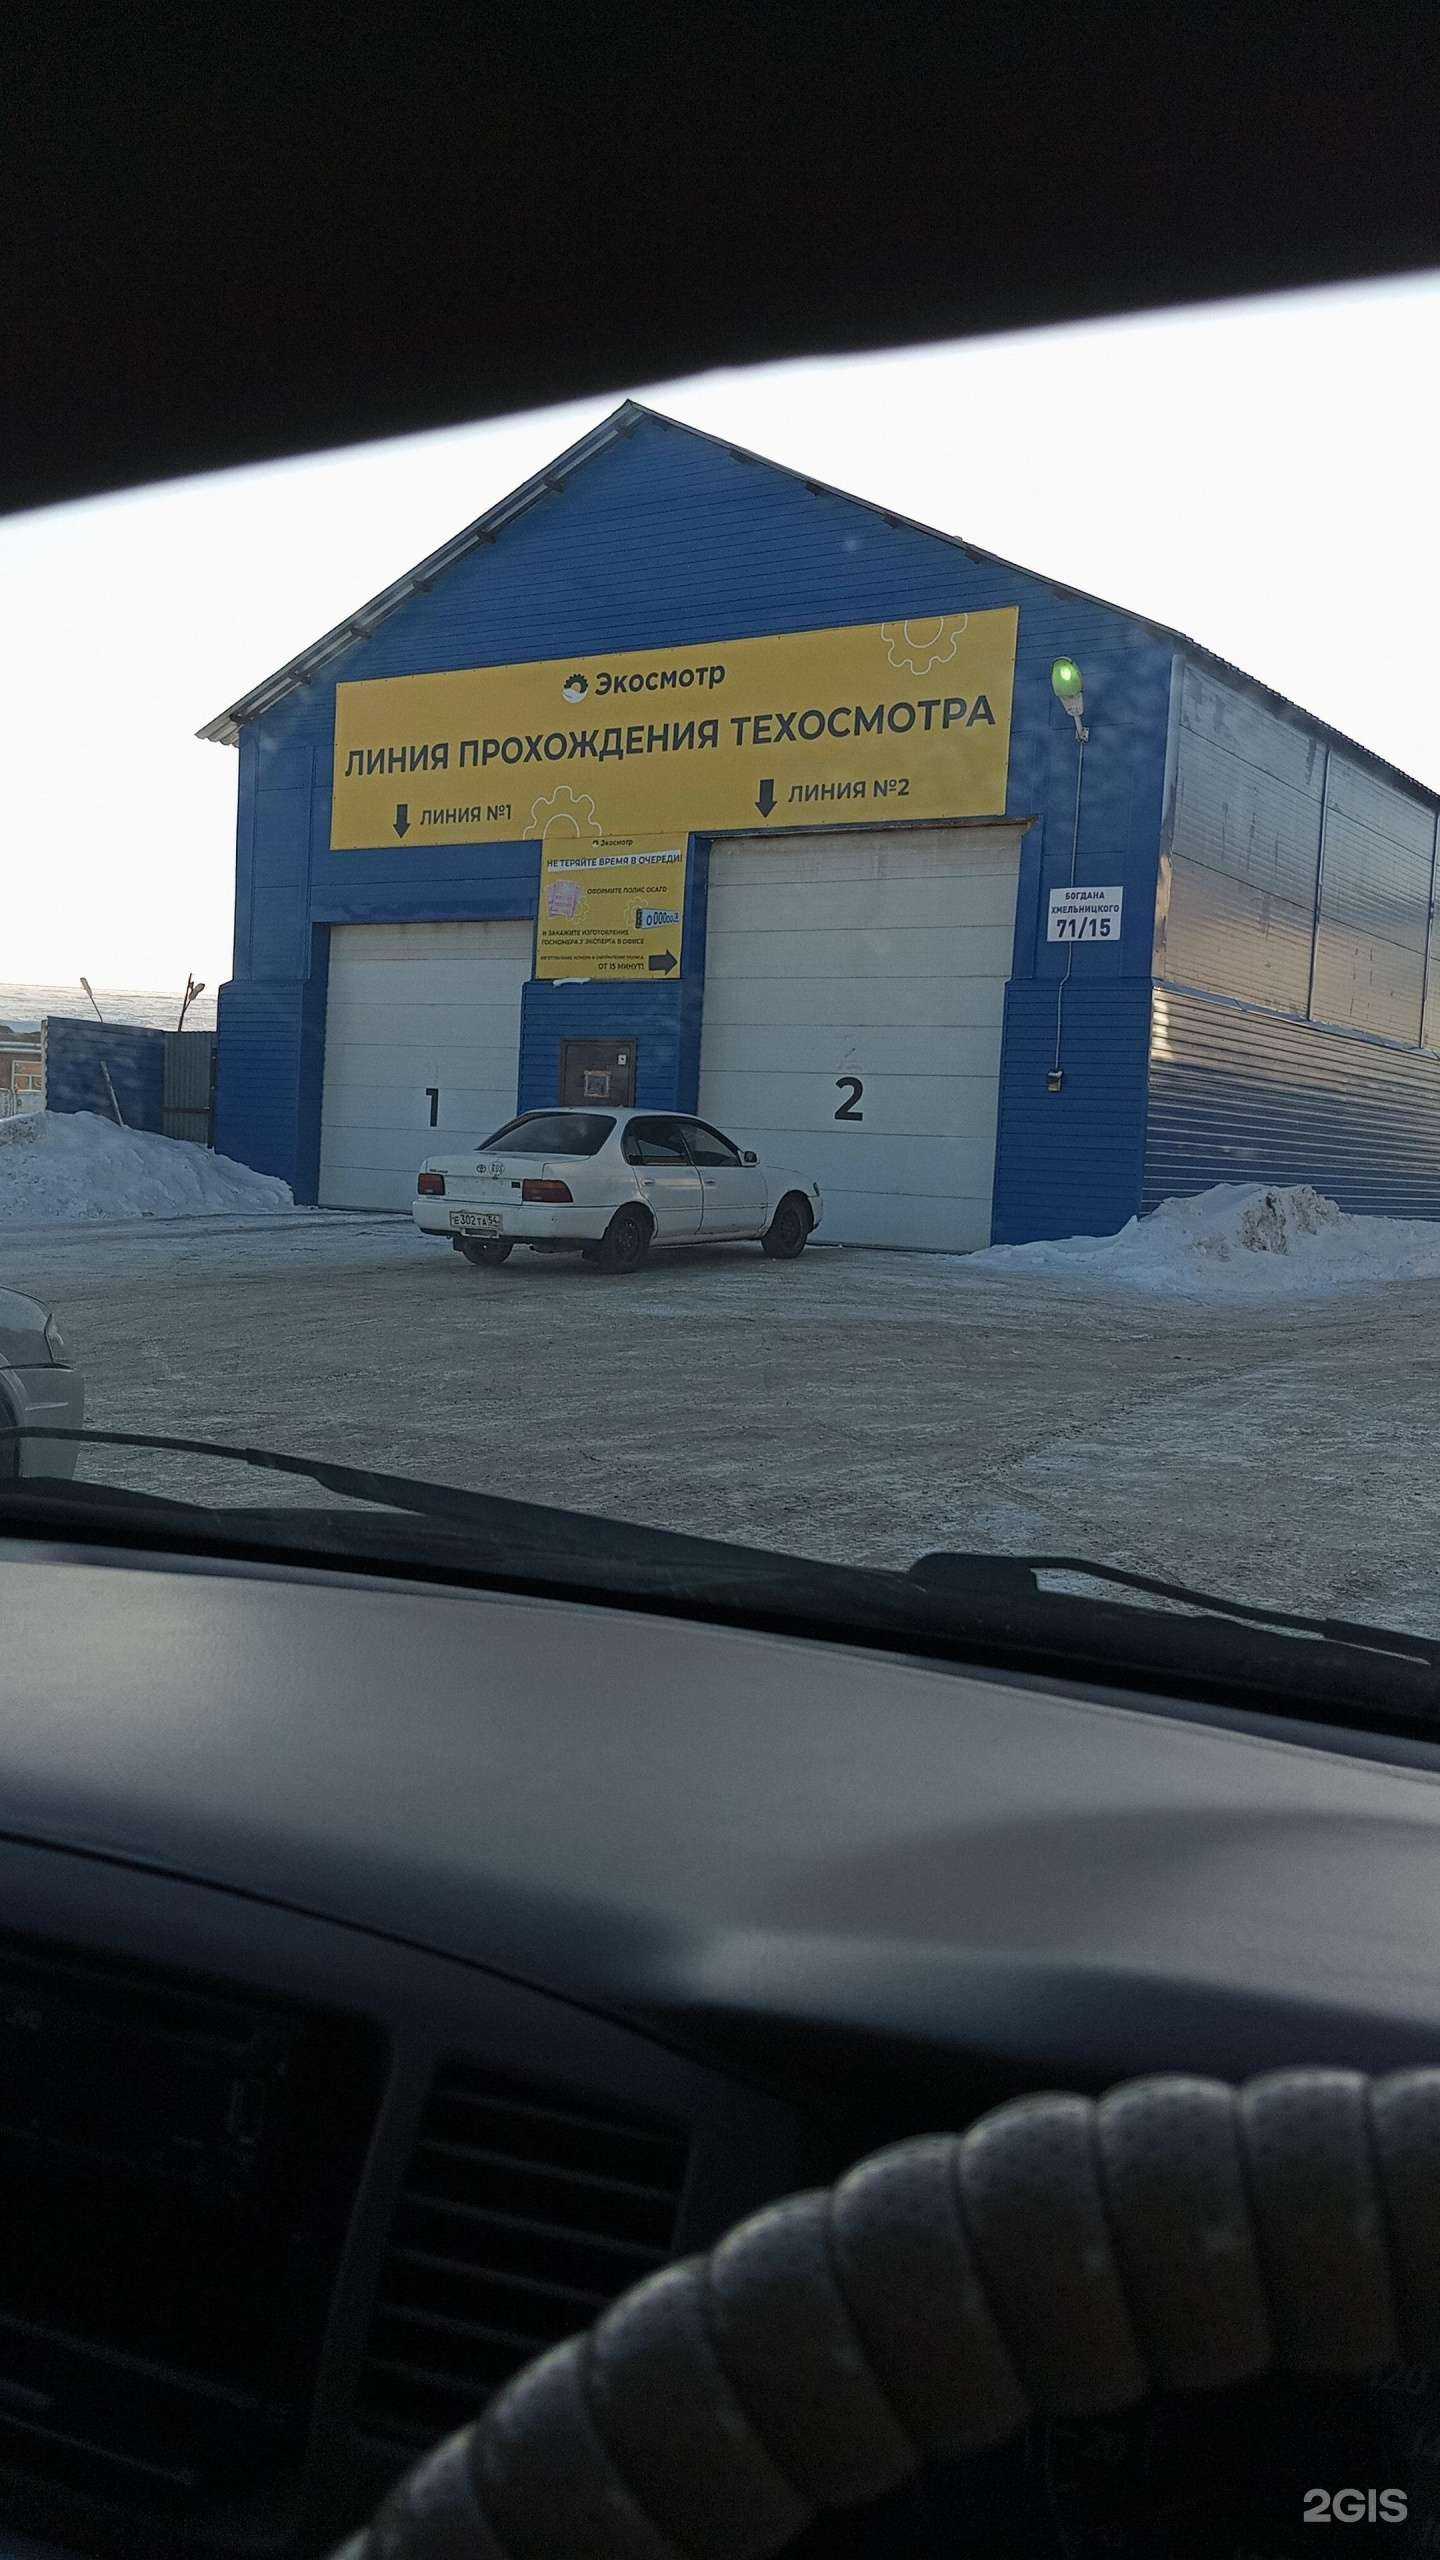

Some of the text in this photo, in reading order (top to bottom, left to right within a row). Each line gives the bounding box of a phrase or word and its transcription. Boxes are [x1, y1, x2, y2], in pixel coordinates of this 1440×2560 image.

[595, 664, 726, 695] Экосмотр
[345, 694, 996, 777] ЛИНИЯ ПРОХОЖДЕНИЯ ТЕХОСМОТРА
[788, 778, 910, 803] ЛИНИЯ №2
[420, 804, 512, 826] ЛИНИЯ №1
[547, 859, 558, 868] НЕ
[560, 857, 597, 868] ТЕРЯЙТЕ
[599, 855, 629, 866] ВРЕМЯ
[630, 855, 637, 865] В
[1065, 891, 1105, 900] БОГДАНА
[1051, 904, 1120, 914] ХМЕЛЬНИЦКОГО
[1056, 916, 1112, 939] 71/15
[425, 1088, 439, 1127] 1
[834, 1076, 864, 1121] 2
